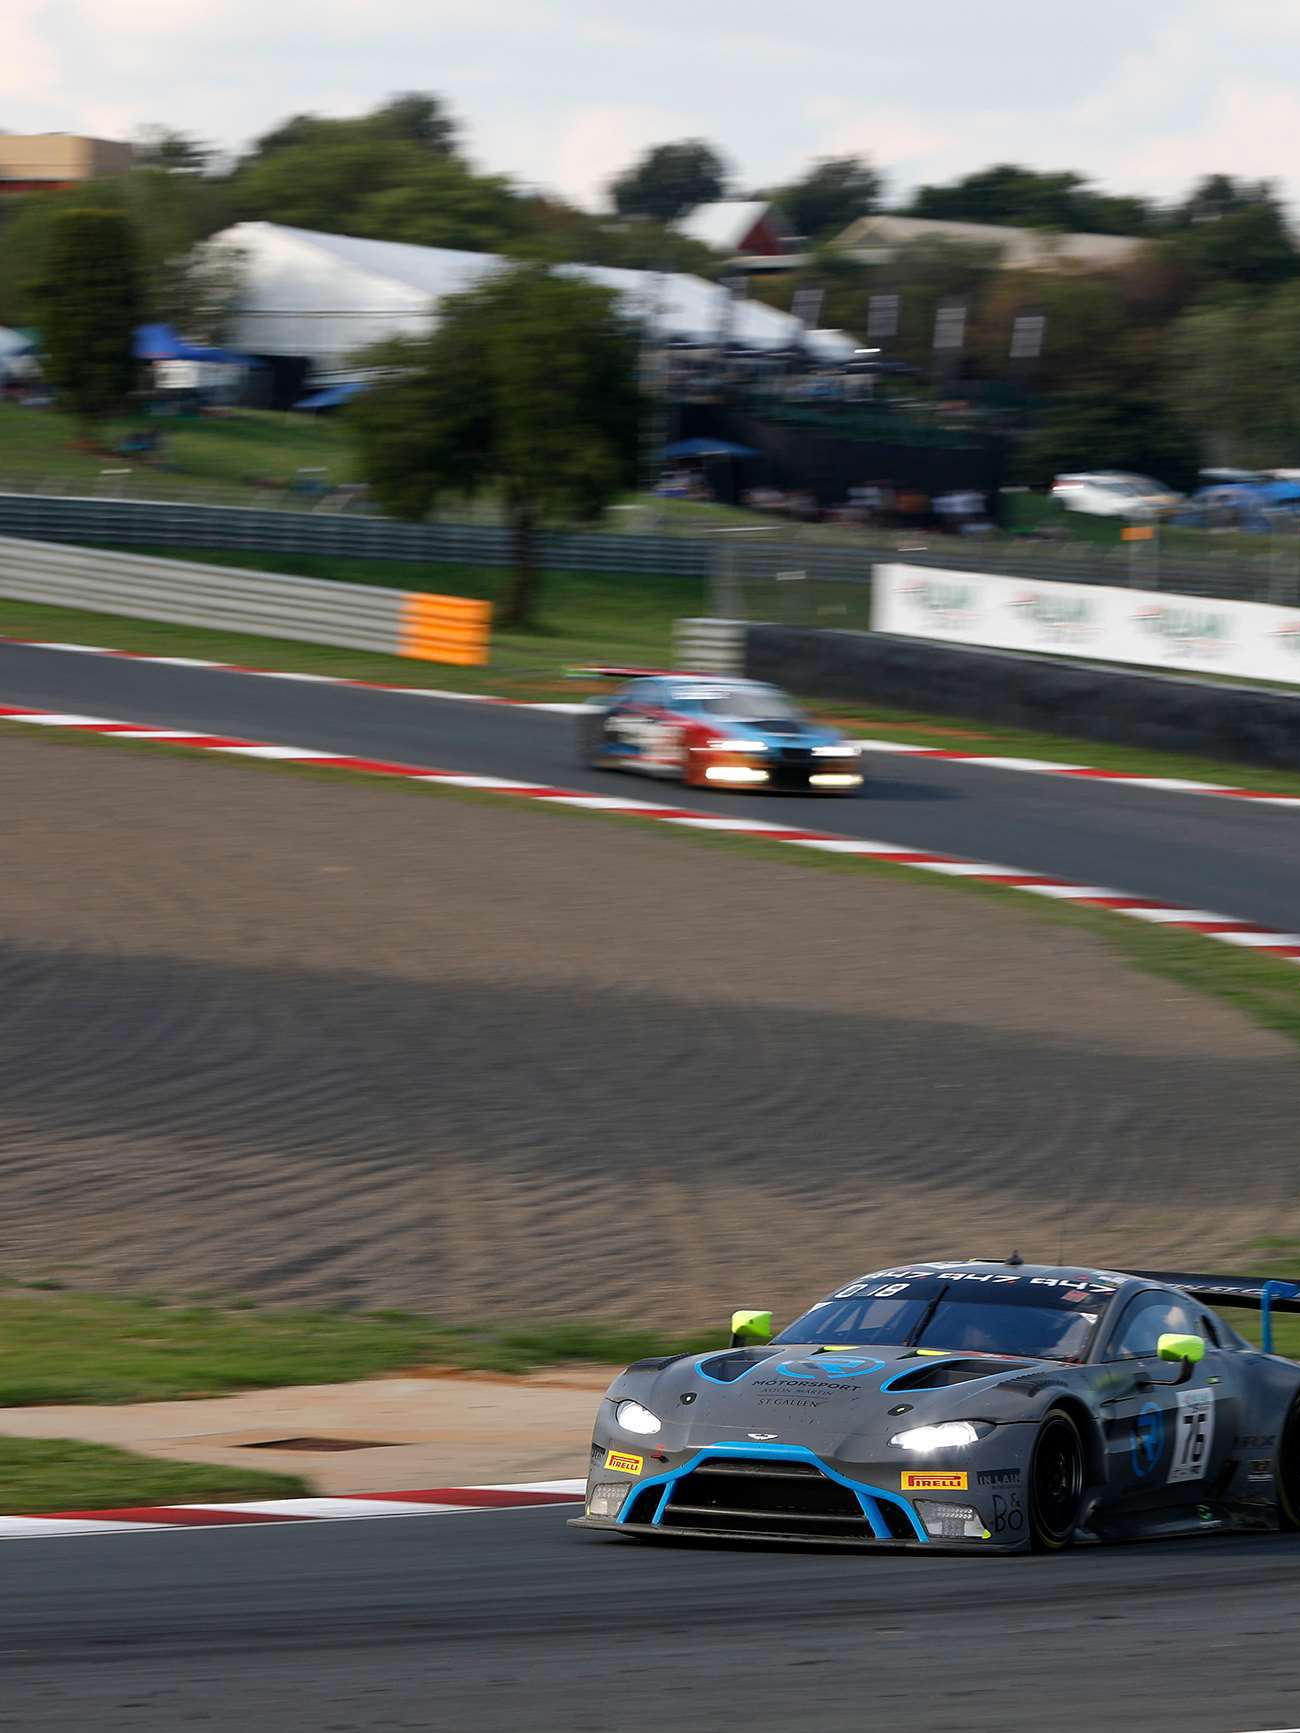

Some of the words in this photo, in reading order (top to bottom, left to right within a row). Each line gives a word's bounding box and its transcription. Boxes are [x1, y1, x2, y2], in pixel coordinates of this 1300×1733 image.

[752, 1379, 861, 1392] MOTORSPORT
[609, 1455, 640, 1471] PIRELLI
[908, 1475, 961, 1487] PIRELLI
